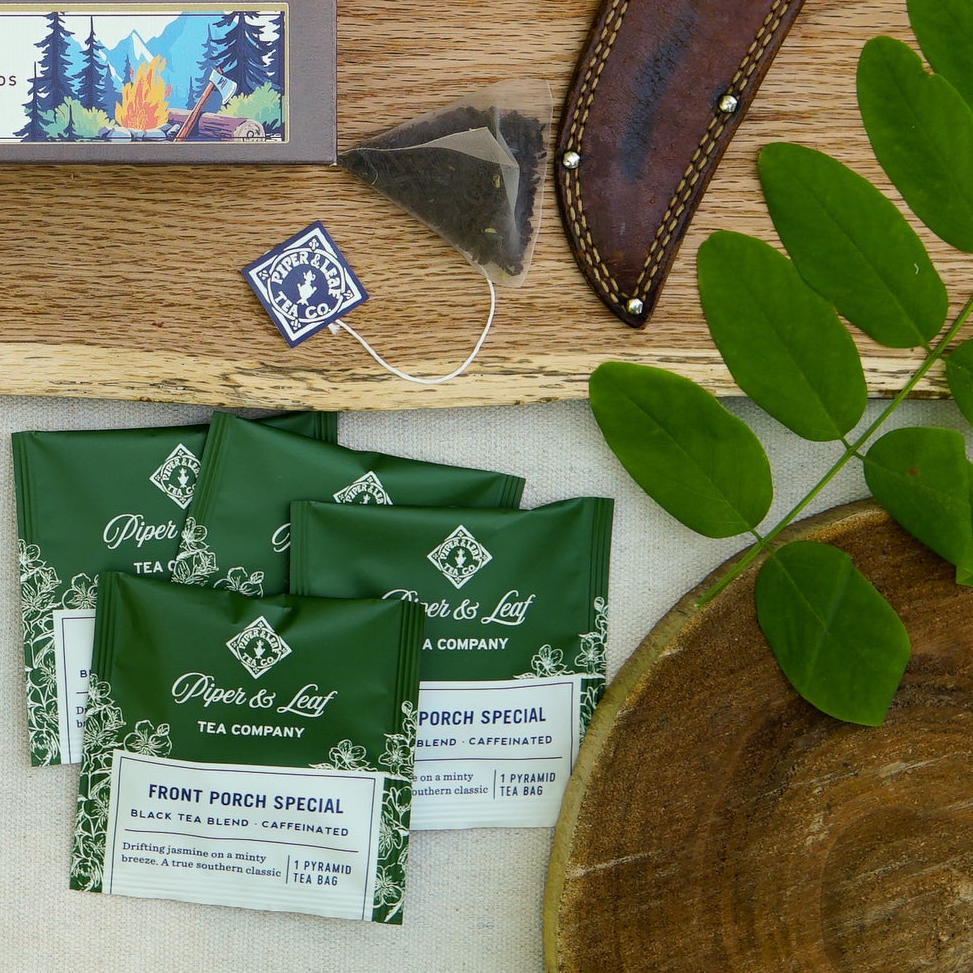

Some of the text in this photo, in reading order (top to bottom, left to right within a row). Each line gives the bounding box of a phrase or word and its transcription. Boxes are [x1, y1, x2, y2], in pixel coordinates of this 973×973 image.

[172, 673, 338, 717] Piper & Leaf
[198, 721, 304, 737] TEA COMPANY
[149, 784, 343, 813] FRONT PORCH SPECIAL
[131, 809, 348, 836] BLACK TEA BLEND CAFFEINATED
[123, 842, 165, 854] Drifting
[166, 848, 208, 857] jasmine
[236, 854, 266, 863] minty
[122, 854, 159, 865] breeze.
[196, 863, 242, 873] southern
[246, 866, 281, 877] classic
[295, 860, 351, 874] 1 PYRAMID
[294, 873, 337, 886] TEA BAG
